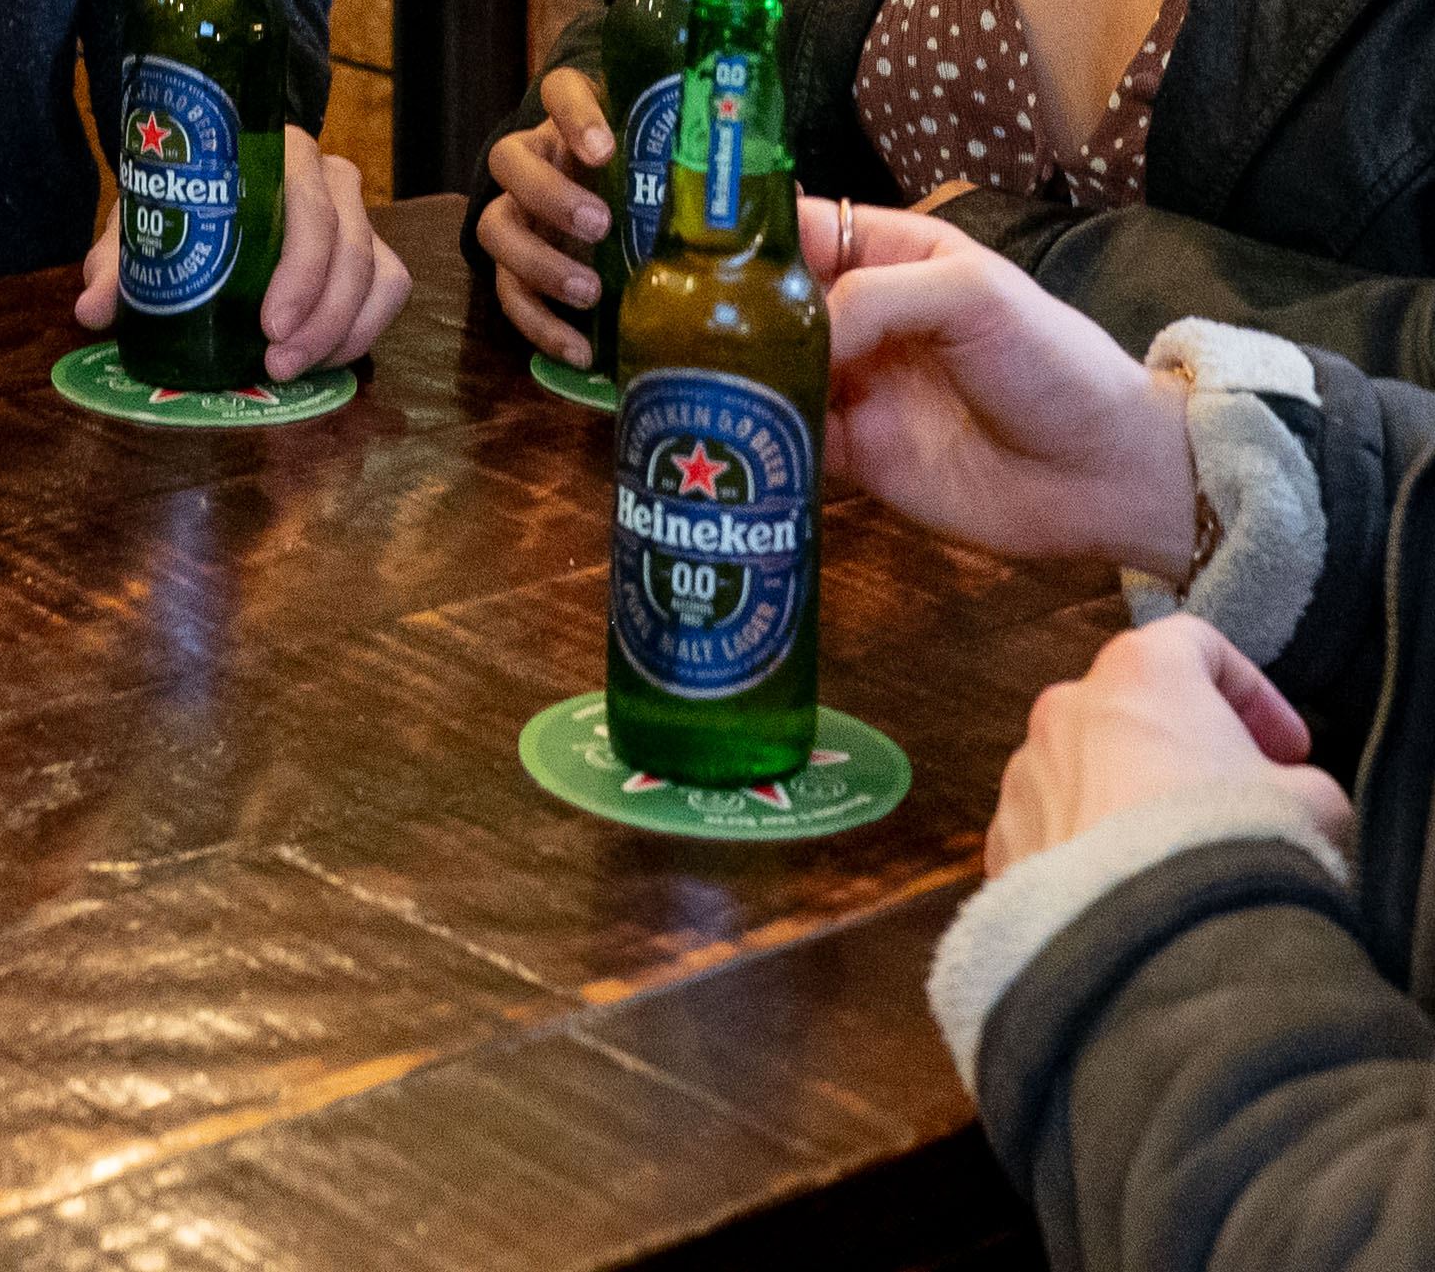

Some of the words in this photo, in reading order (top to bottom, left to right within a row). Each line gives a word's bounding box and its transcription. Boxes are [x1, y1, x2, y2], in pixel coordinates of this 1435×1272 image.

[120, 158, 229, 204] eineken
[130, 261, 162, 287] MALT
[168, 241, 213, 285] LAGER
[618, 485, 796, 555] Heineken
